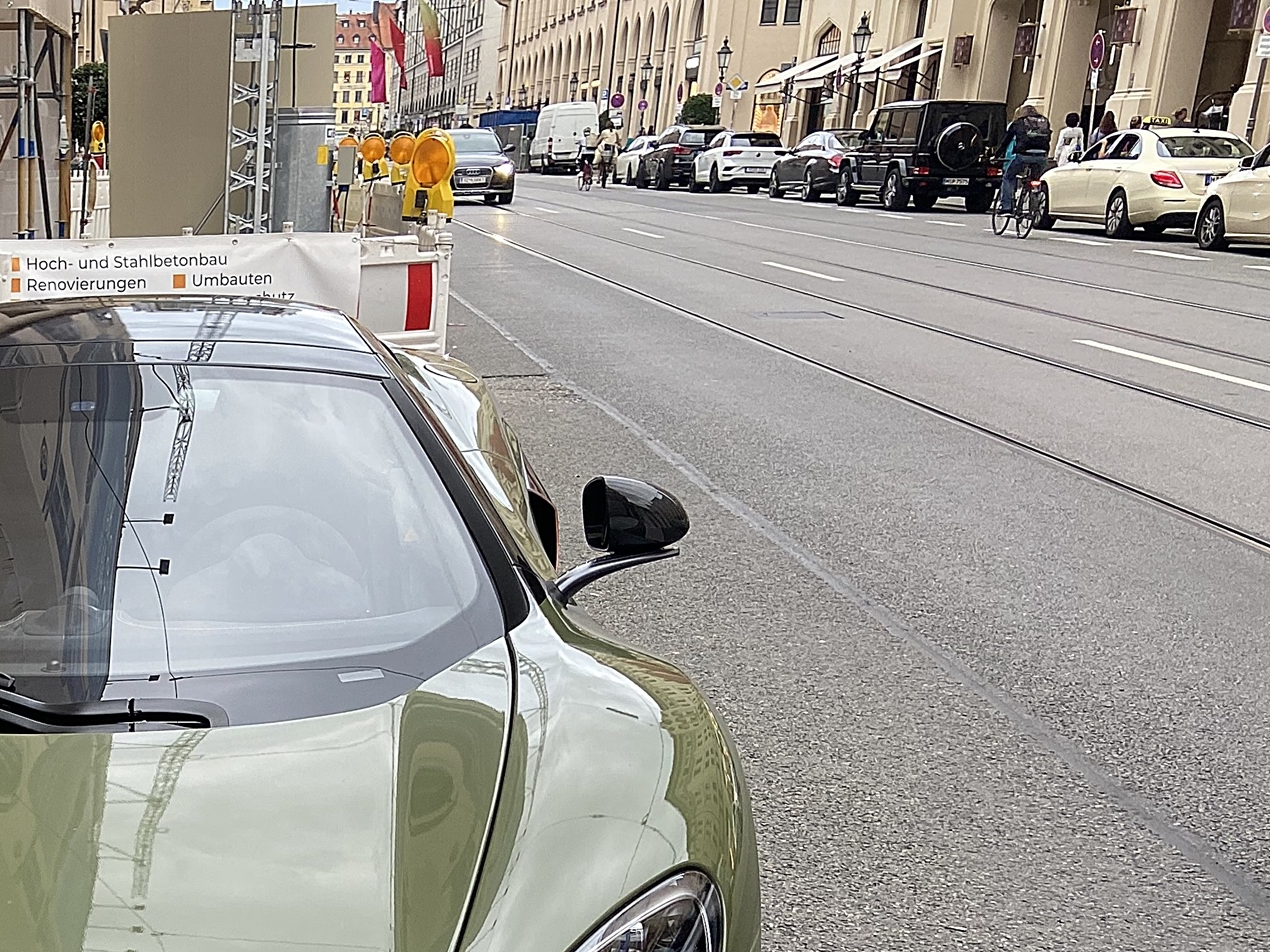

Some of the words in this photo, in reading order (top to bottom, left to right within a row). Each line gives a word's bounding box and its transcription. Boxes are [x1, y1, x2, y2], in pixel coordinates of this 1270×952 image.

[26, 256, 73, 271] Hoch-
[78, 255, 109, 270] und
[113, 252, 228, 269] Stahlbetonbau
[27, 276, 147, 293] Renovierungen
[192, 273, 272, 287] Umbauten
